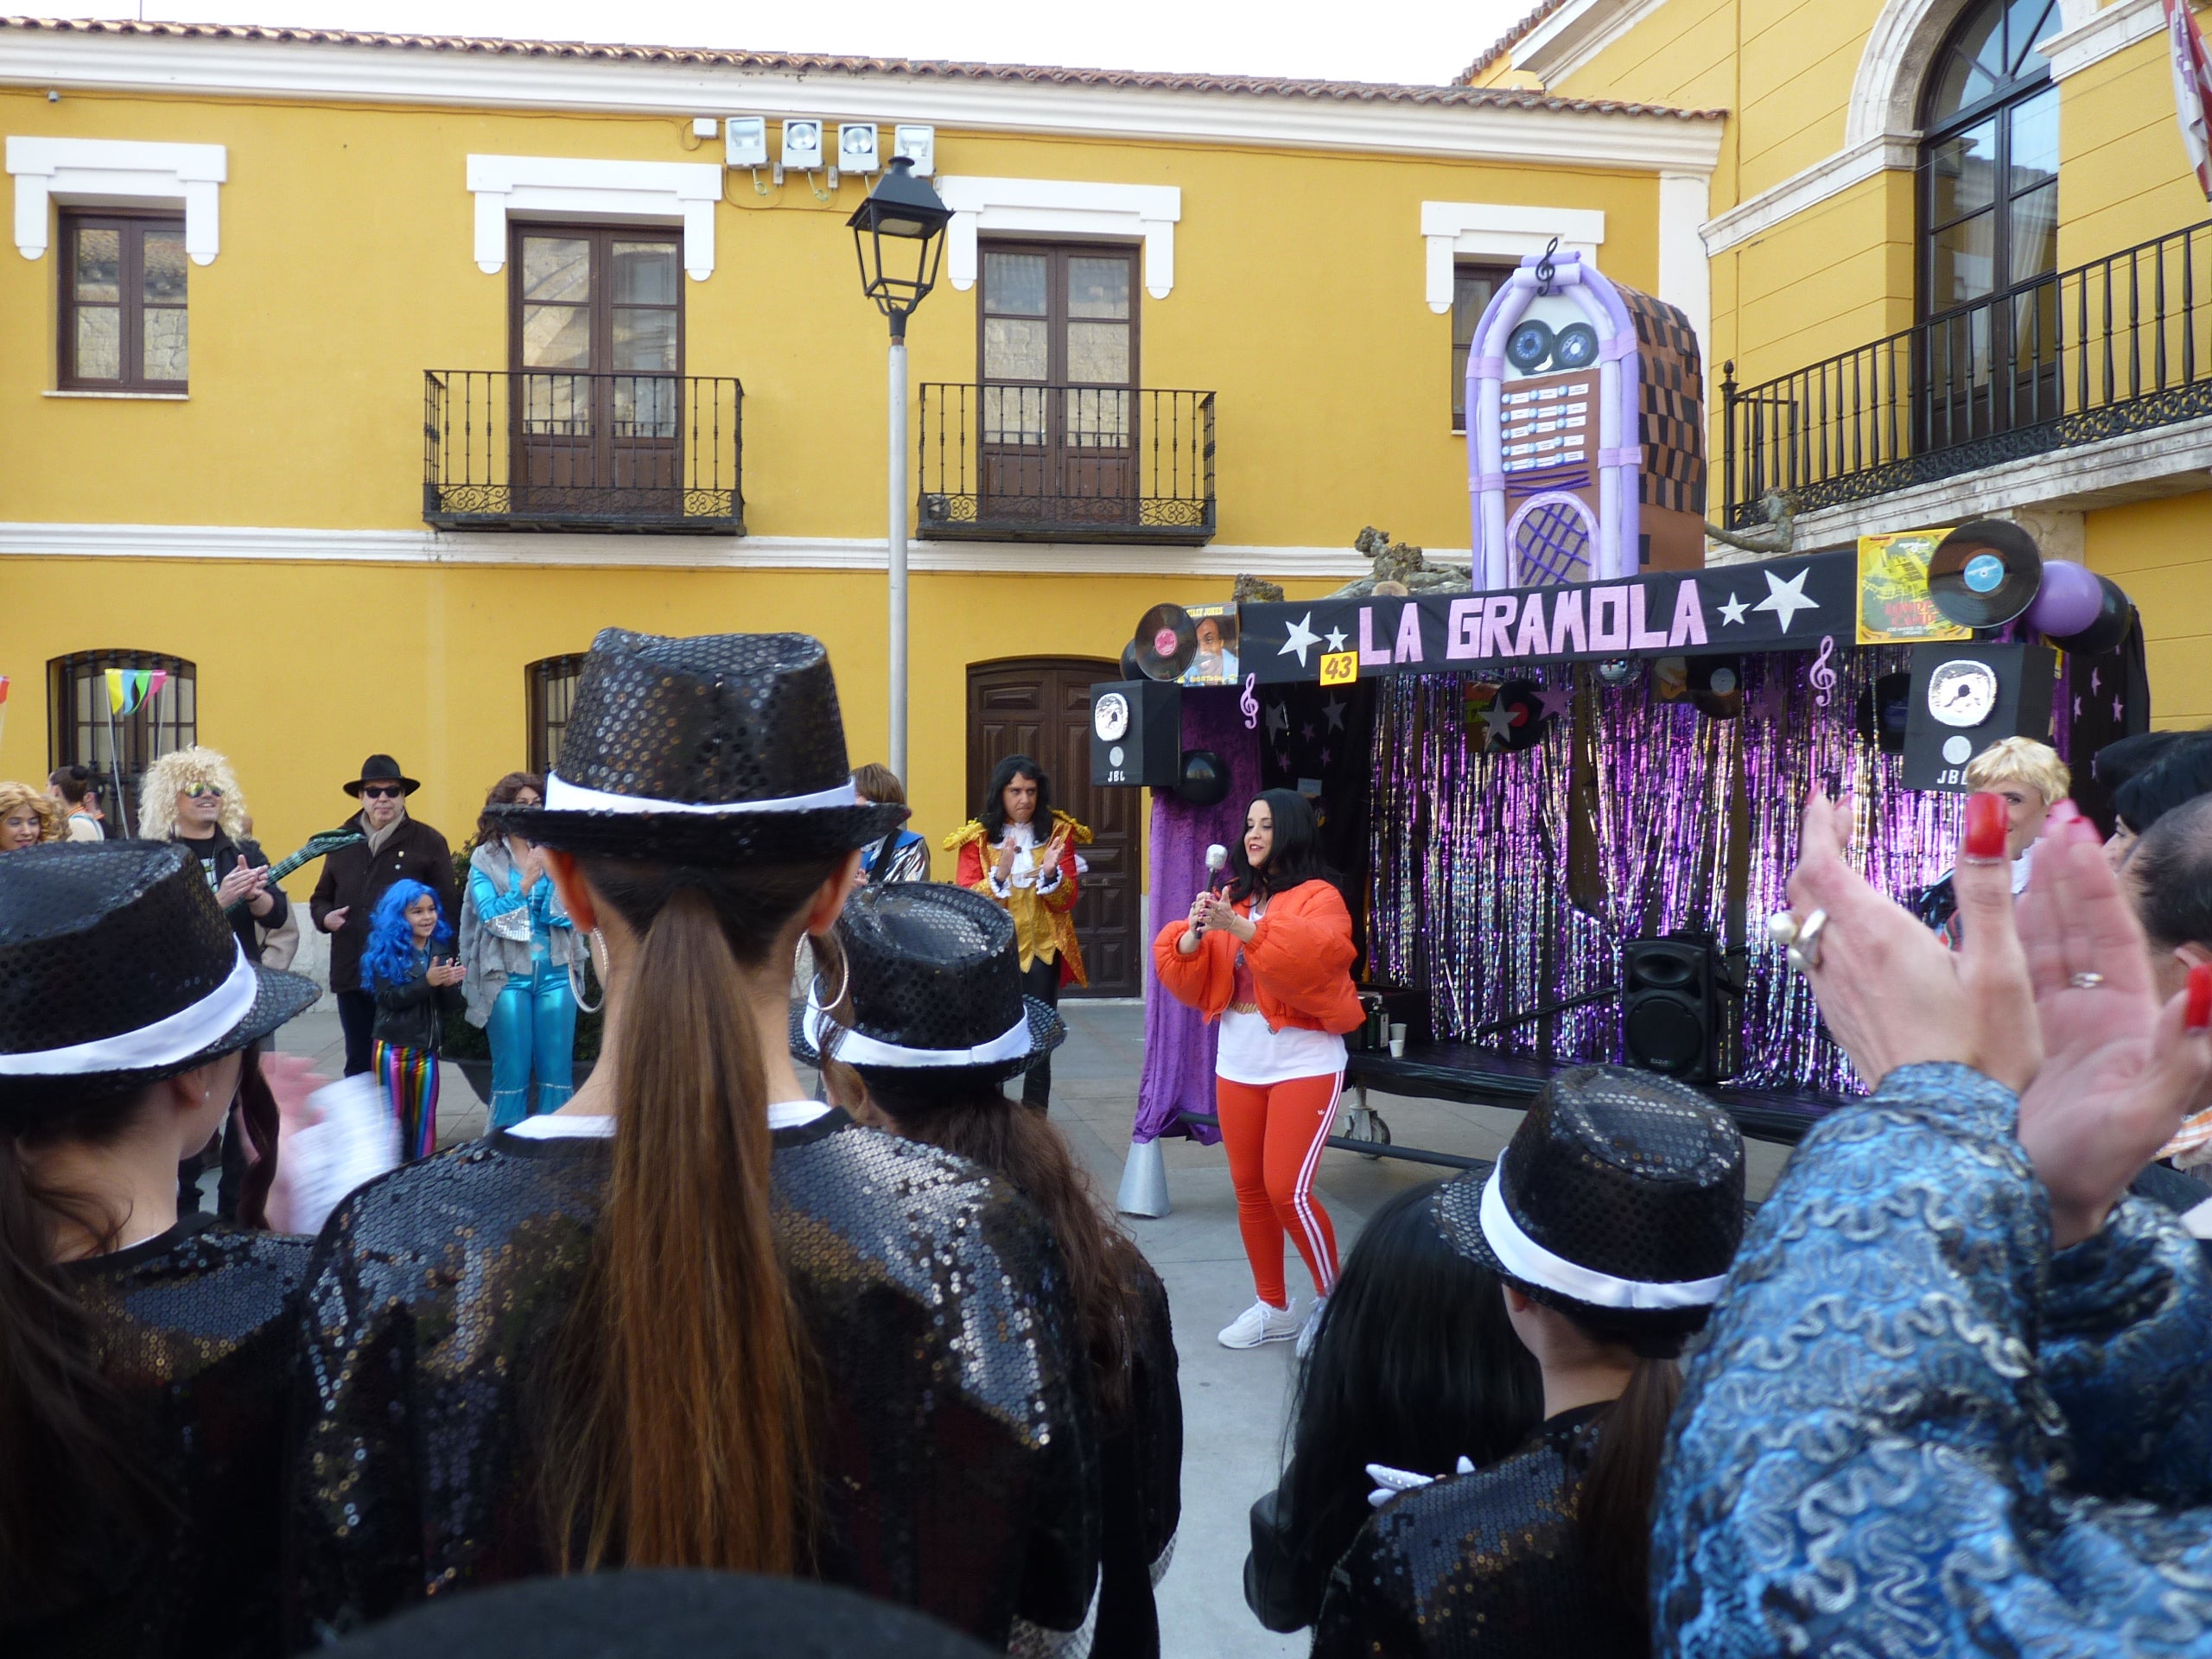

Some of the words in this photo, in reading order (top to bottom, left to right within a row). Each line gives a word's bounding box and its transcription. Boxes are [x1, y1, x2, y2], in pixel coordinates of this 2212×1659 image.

[1359, 602, 1423, 666] LA
[1446, 579, 1708, 660] GRAMOLA
[1325, 656, 1352, 680] 43
[1108, 770, 1126, 783] JBL
[1936, 769, 1967, 785] JBL
